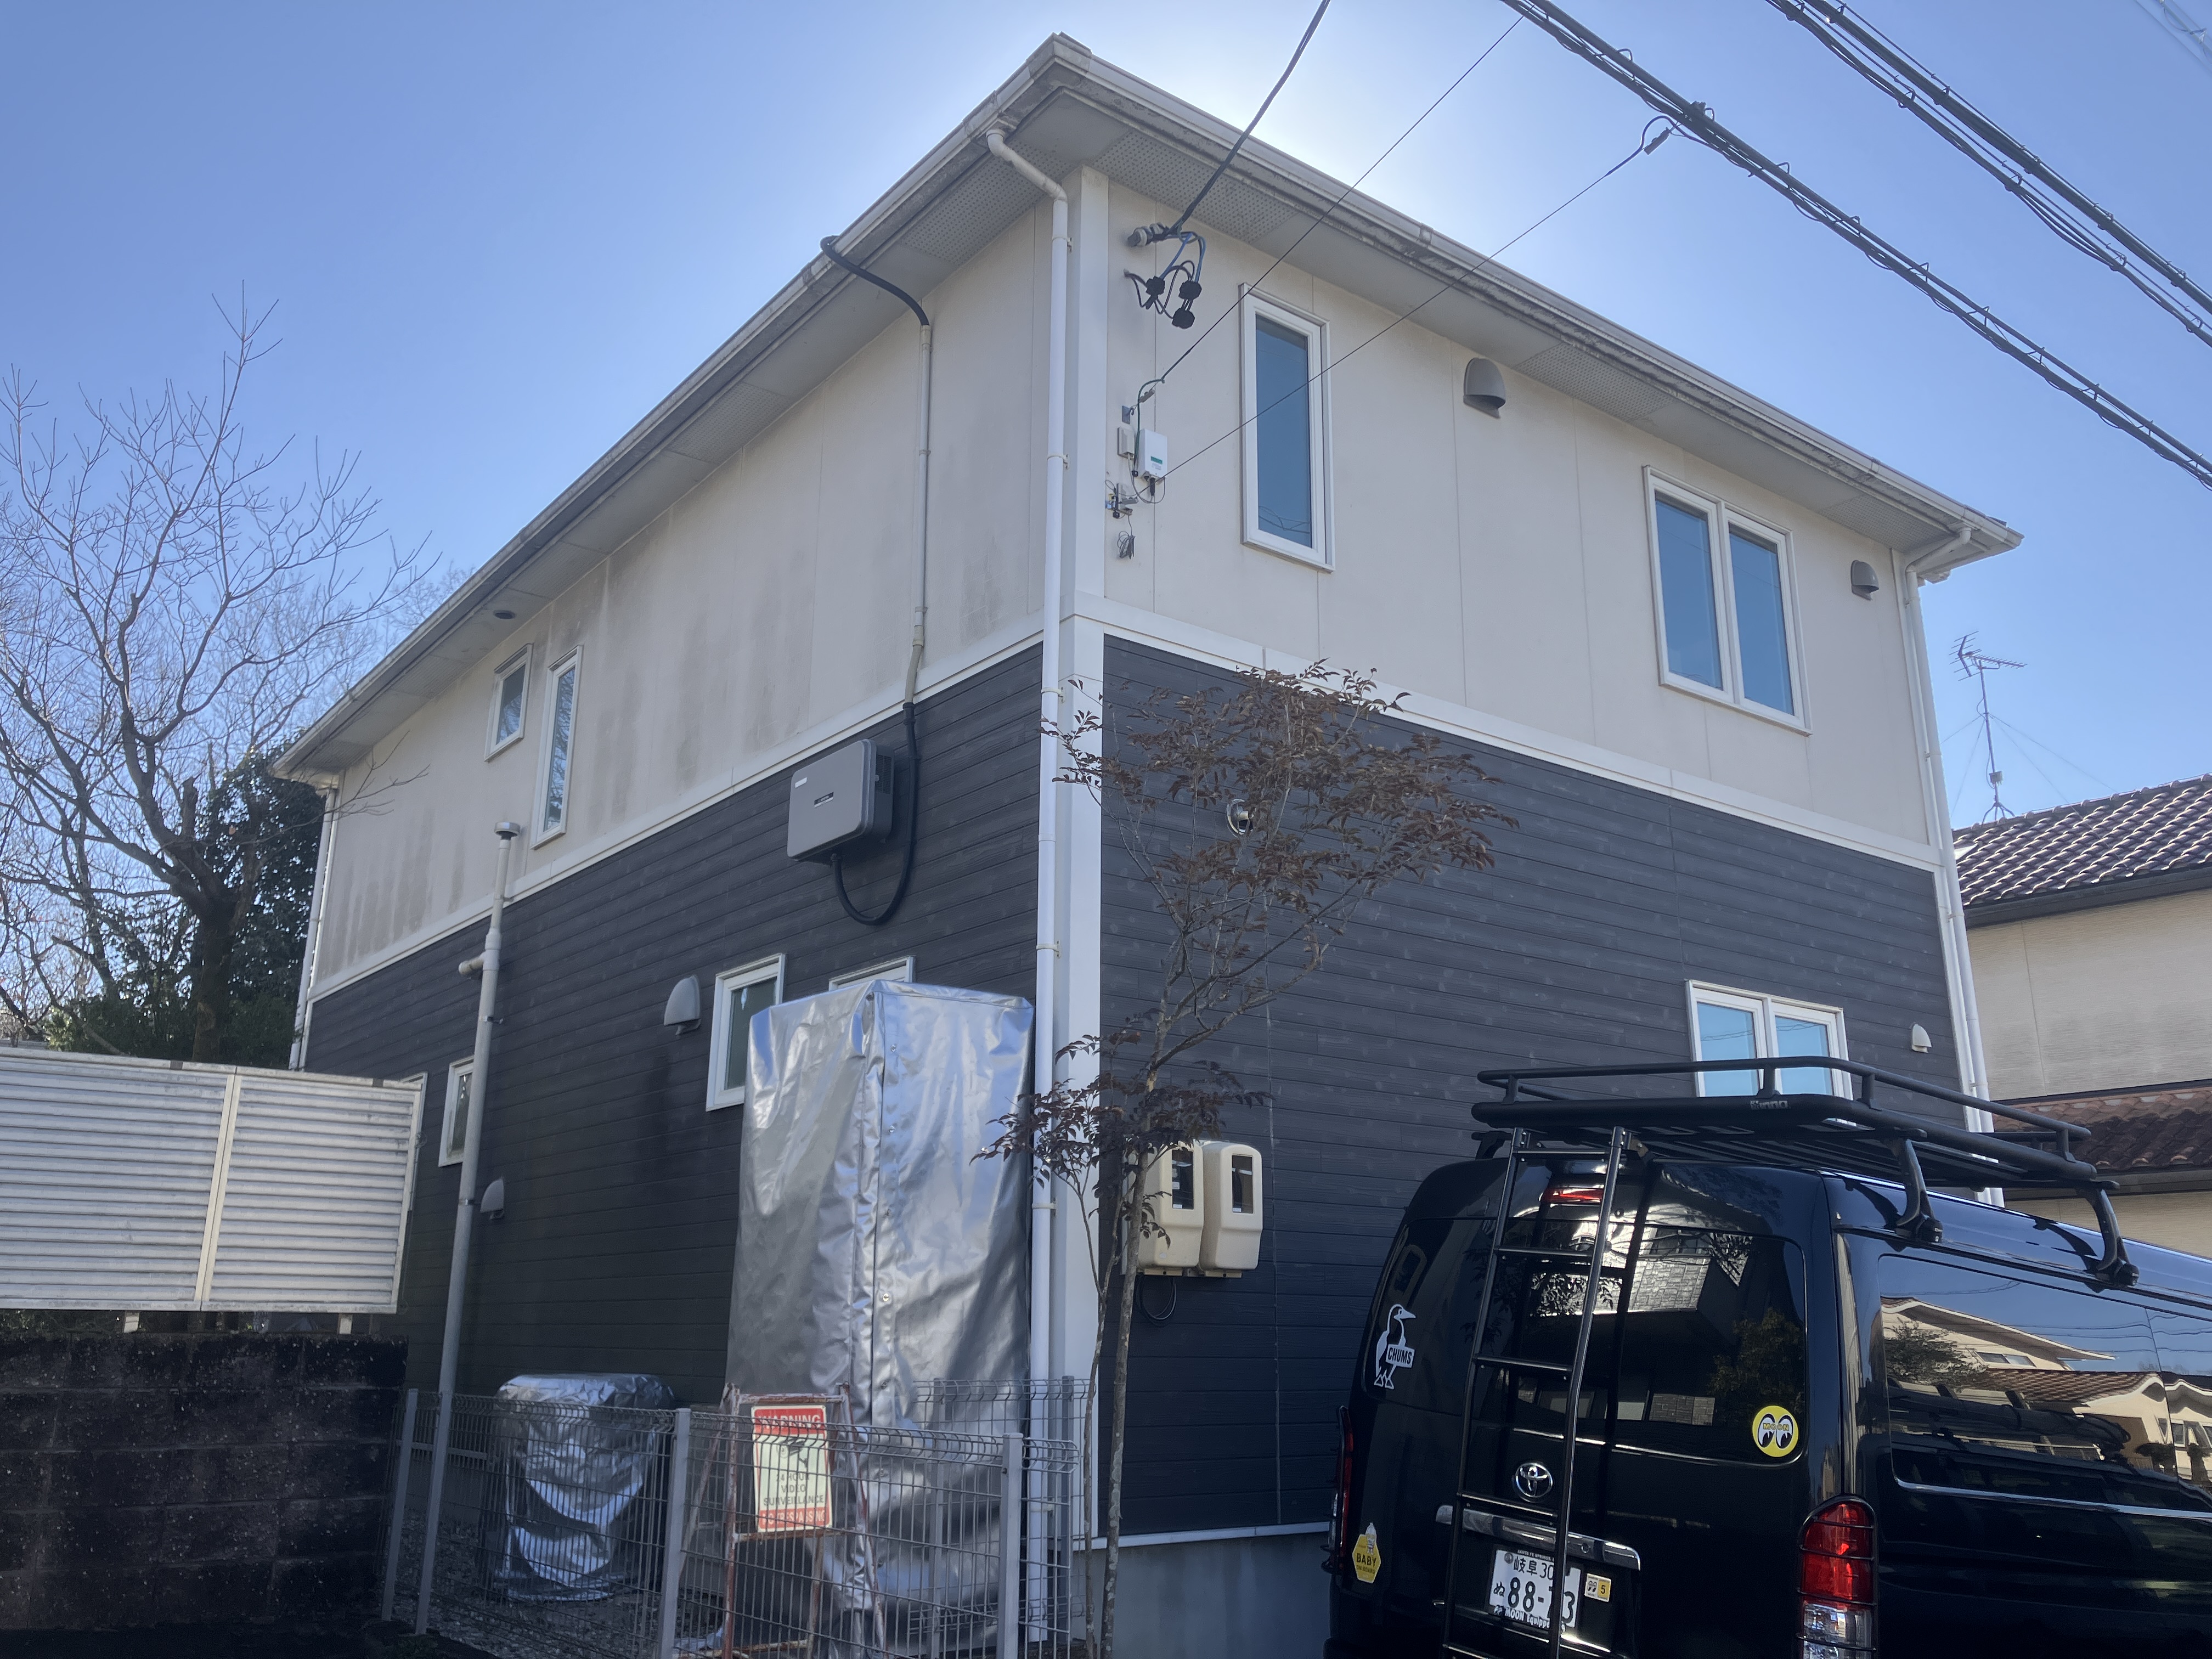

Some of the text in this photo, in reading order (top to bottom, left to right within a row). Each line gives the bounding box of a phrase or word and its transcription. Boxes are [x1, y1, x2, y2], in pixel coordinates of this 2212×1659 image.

[1387, 1347, 1412, 1364] CHUMS
[758, 1414, 821, 1429] WARNING
[1763, 1423, 1789, 1431] MOON
[781, 1484, 806, 1493] VDEO
[763, 1494, 824, 1506] SURVEILANCE
[776, 1510, 826, 1522] RESPASNG
[1356, 1553, 1376, 1567] BABY
[1514, 1556, 1555, 1581] 岐阜 30
[1600, 1585, 1606, 1594] 5
[1493, 1577, 1575, 1624] ぬ 88-3
[1505, 1606, 1550, 1629] MOON Equippe
